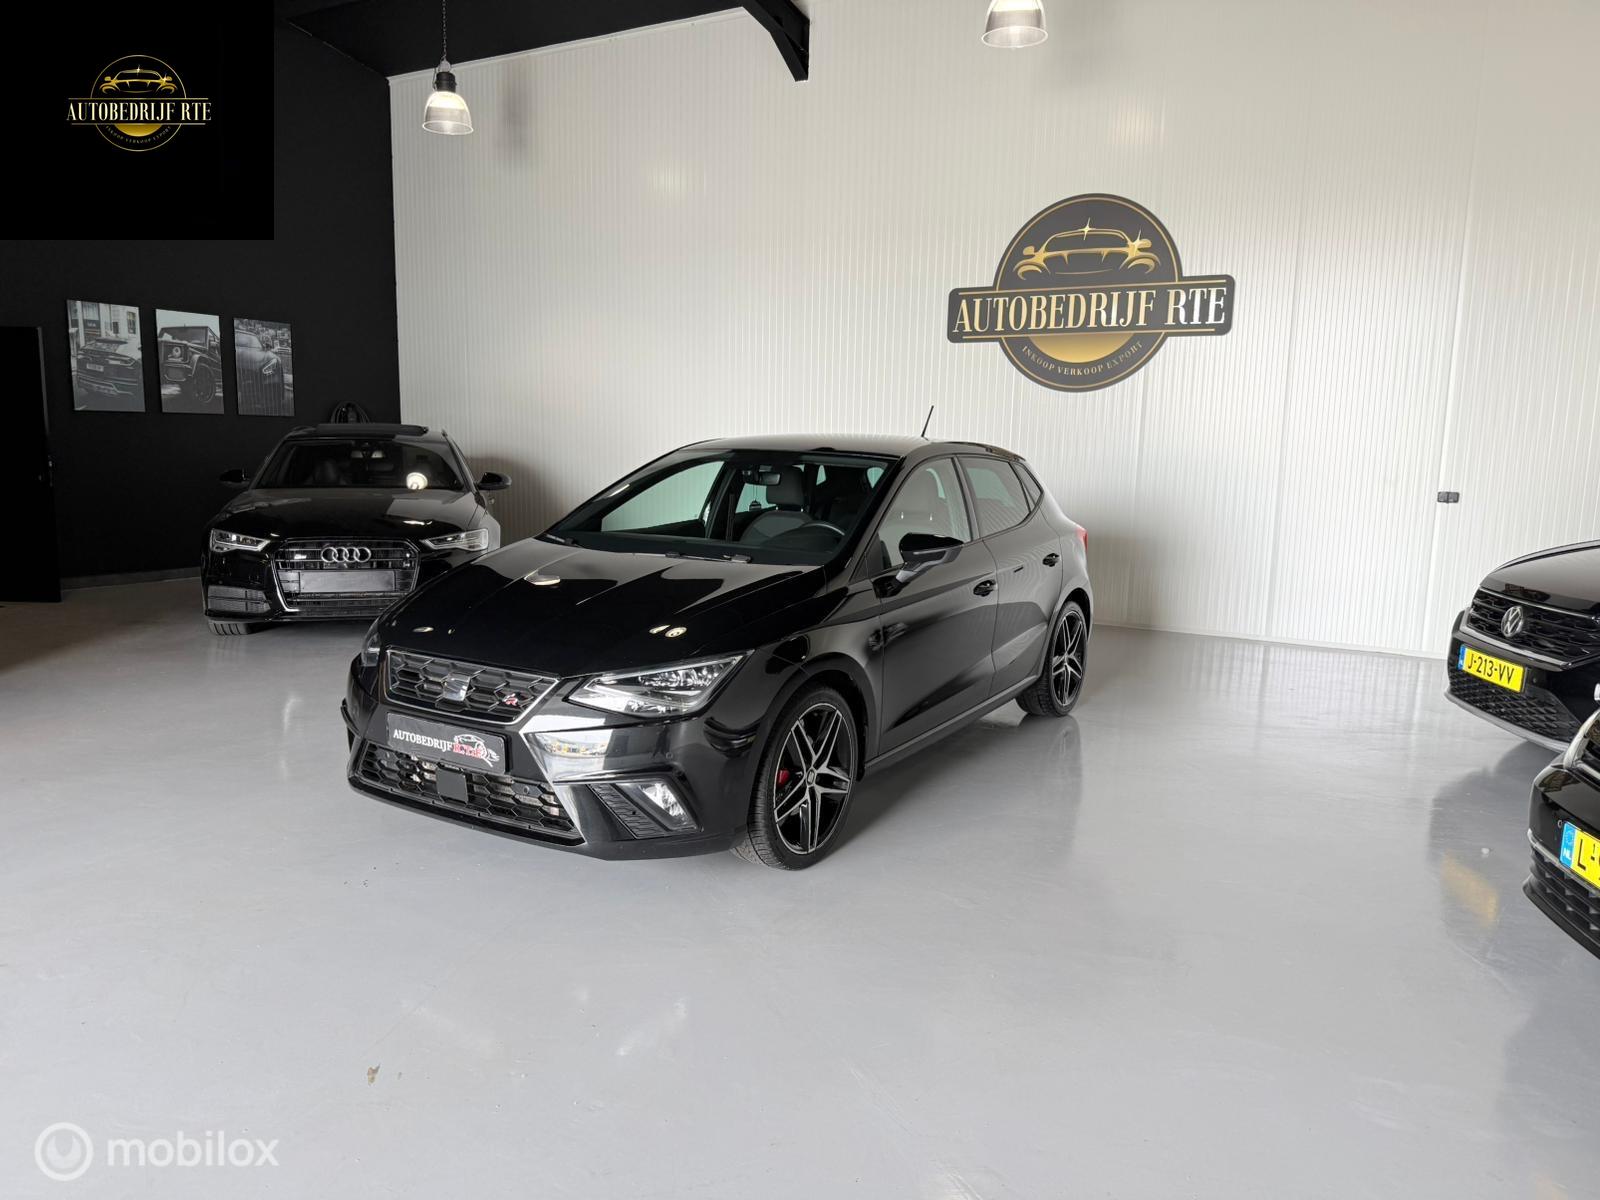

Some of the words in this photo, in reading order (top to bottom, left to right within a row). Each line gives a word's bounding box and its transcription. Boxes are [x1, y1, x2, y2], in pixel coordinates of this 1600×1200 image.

[952, 289, 1156, 333] AUTOBEDRIJF
[1164, 287, 1227, 326] RTE
[1022, 345, 1055, 371] INKOOP
[1057, 365, 1104, 376] VERKOOP
[1106, 341, 1143, 370] EXPORT
[1468, 653, 1514, 685] J-213-VV
[393, 729, 454, 752] AUTOBEDRIJF
